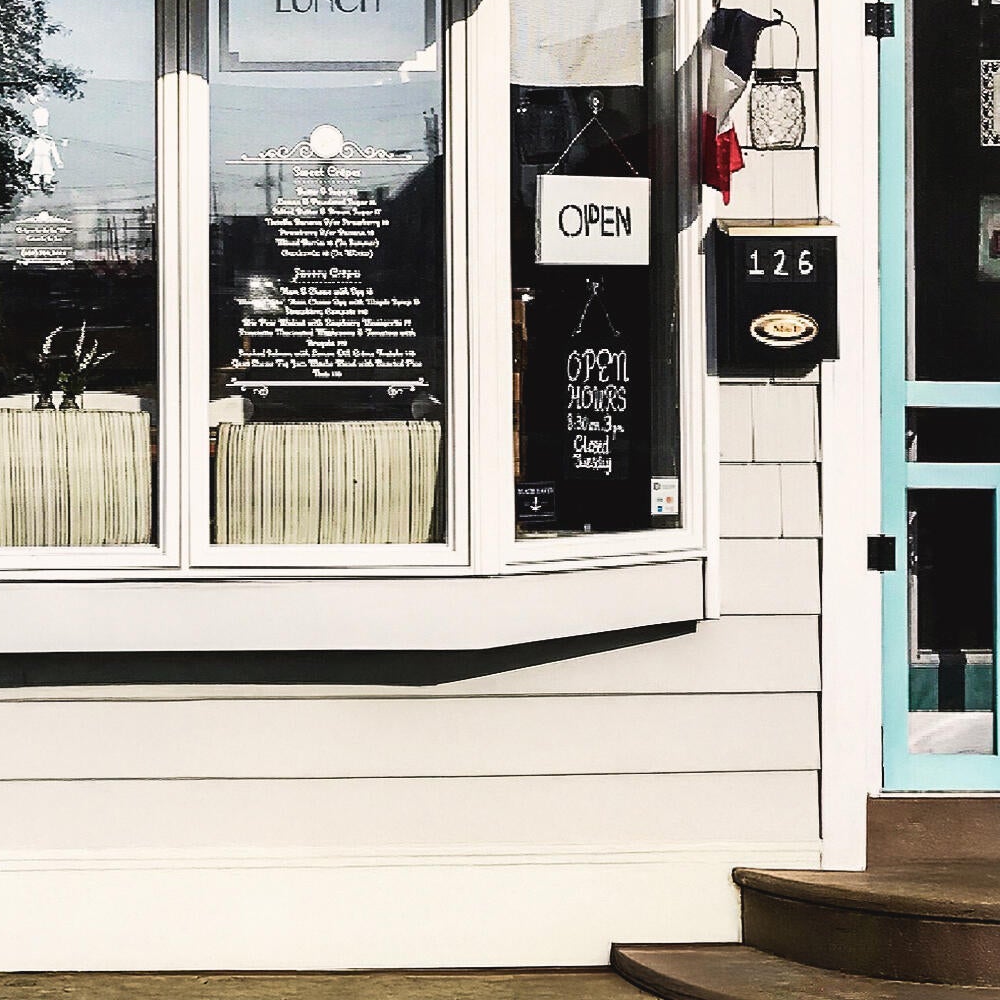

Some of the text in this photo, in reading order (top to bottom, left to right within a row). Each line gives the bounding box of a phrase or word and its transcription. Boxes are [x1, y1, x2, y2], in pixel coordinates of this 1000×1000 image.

[558, 204, 632, 237] OPEN
[748, 249, 814, 275] 126
[567, 348, 630, 382] OPEN
[567, 384, 627, 412] HOURS
